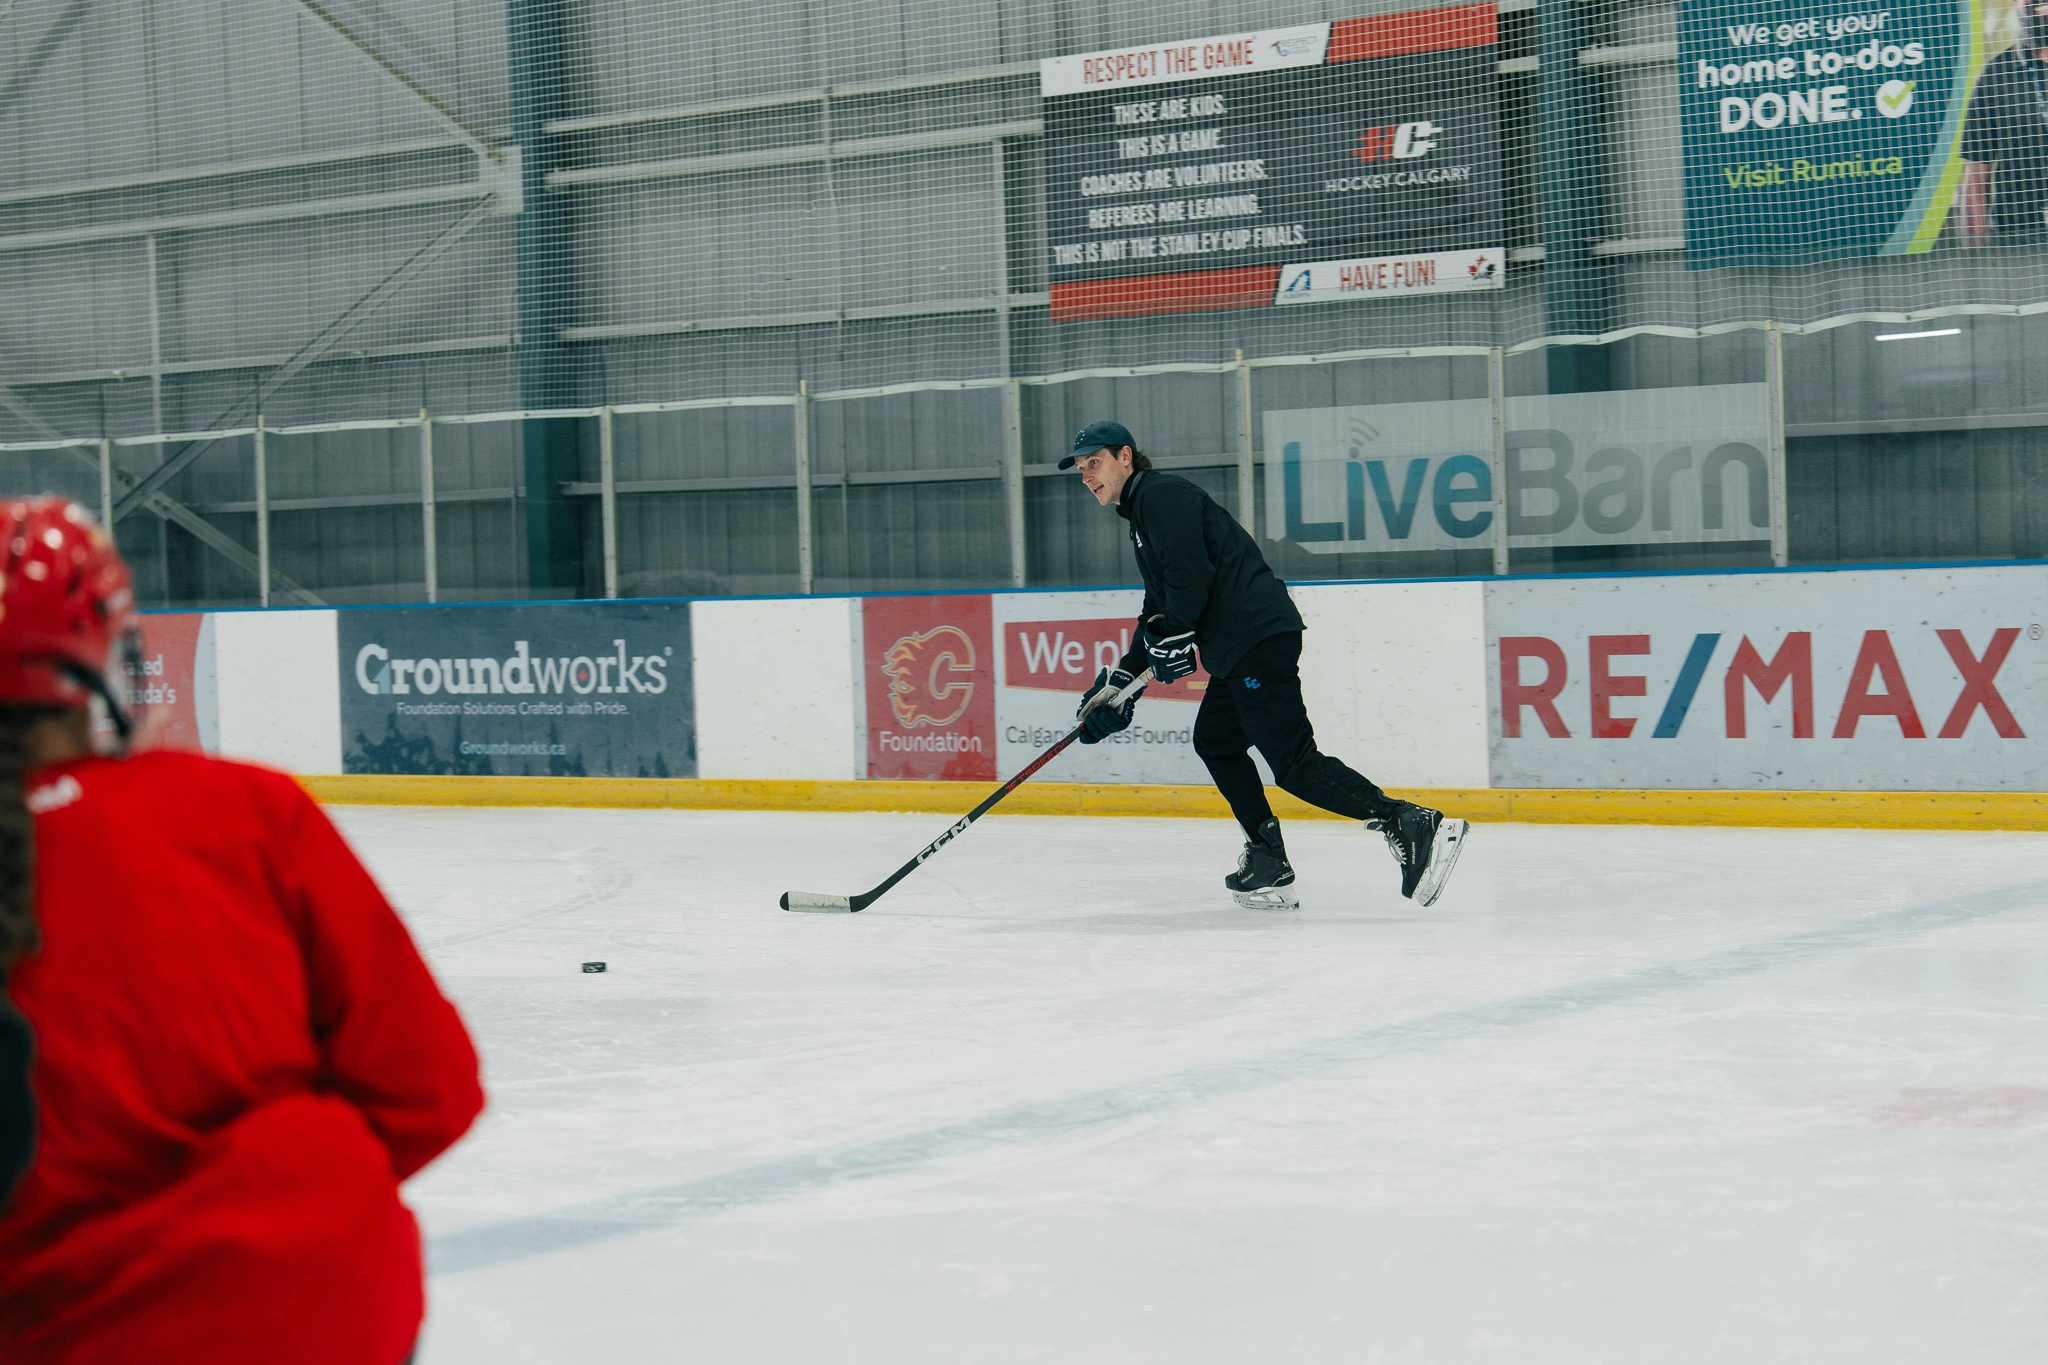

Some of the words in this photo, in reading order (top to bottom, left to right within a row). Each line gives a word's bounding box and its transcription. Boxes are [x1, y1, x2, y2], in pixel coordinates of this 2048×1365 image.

[1726, 22, 1770, 47] We
[1775, 16, 1821, 47] get
[1826, 11, 1892, 42] your
[1084, 51, 1158, 84] RESPECT
[1164, 46, 1198, 75] THE
[1203, 39, 1254, 70] GAME
[1697, 56, 1796, 89] home
[1804, 39, 1925, 76] to-dos
[1113, 101, 1157, 125] THESE
[1159, 98, 1188, 121] ARE
[1190, 94, 1228, 117] KIDS.
[1720, 84, 1864, 134] DONE.
[1117, 137, 1150, 159] THIS
[1150, 134, 1166, 156] IS
[1166, 132, 1179, 153] A
[1180, 128, 1226, 151] GAME.
[1080, 170, 1142, 196] COACHES
[1144, 167, 1173, 190] ARE
[1174, 158, 1269, 187] VOLUNTEERS.
[1325, 173, 1392, 192] HOCKEY
[1394, 166, 1472, 187] CALGARY
[1723, 162, 1786, 189] Visit
[1792, 153, 1903, 184] Rumi.ca
[1088, 203, 1156, 229] REFEREES
[1158, 200, 1186, 222] ARE
[1187, 194, 1262, 220] LEARNING.
[1053, 244, 1083, 266] THIS
[1084, 241, 1100, 263] IS
[1101, 239, 1129, 262] NOT
[1129, 237, 1157, 259] THE
[1158, 231, 1221, 257] STANLEY
[1221, 229, 1251, 251] CUP
[1252, 224, 1308, 249] FINALS.
[1339, 263, 1388, 292] HAVE
[1393, 259, 1437, 288] FUN!
[1019, 631, 1085, 674] We
[1094, 628, 1129, 677] pl
[396, 702, 461, 715] Foundation
[462, 701, 517, 715] Solutions
[518, 701, 564, 715] Crafted
[565, 702, 593, 715] with
[593, 702, 630, 715] Pride.
[459, 740, 567, 756] Groundworks.ca
[879, 731, 982, 753] Foundation
[1003, 744, 1064, 794] JETSPEED
[916, 816, 971, 864] CCM
